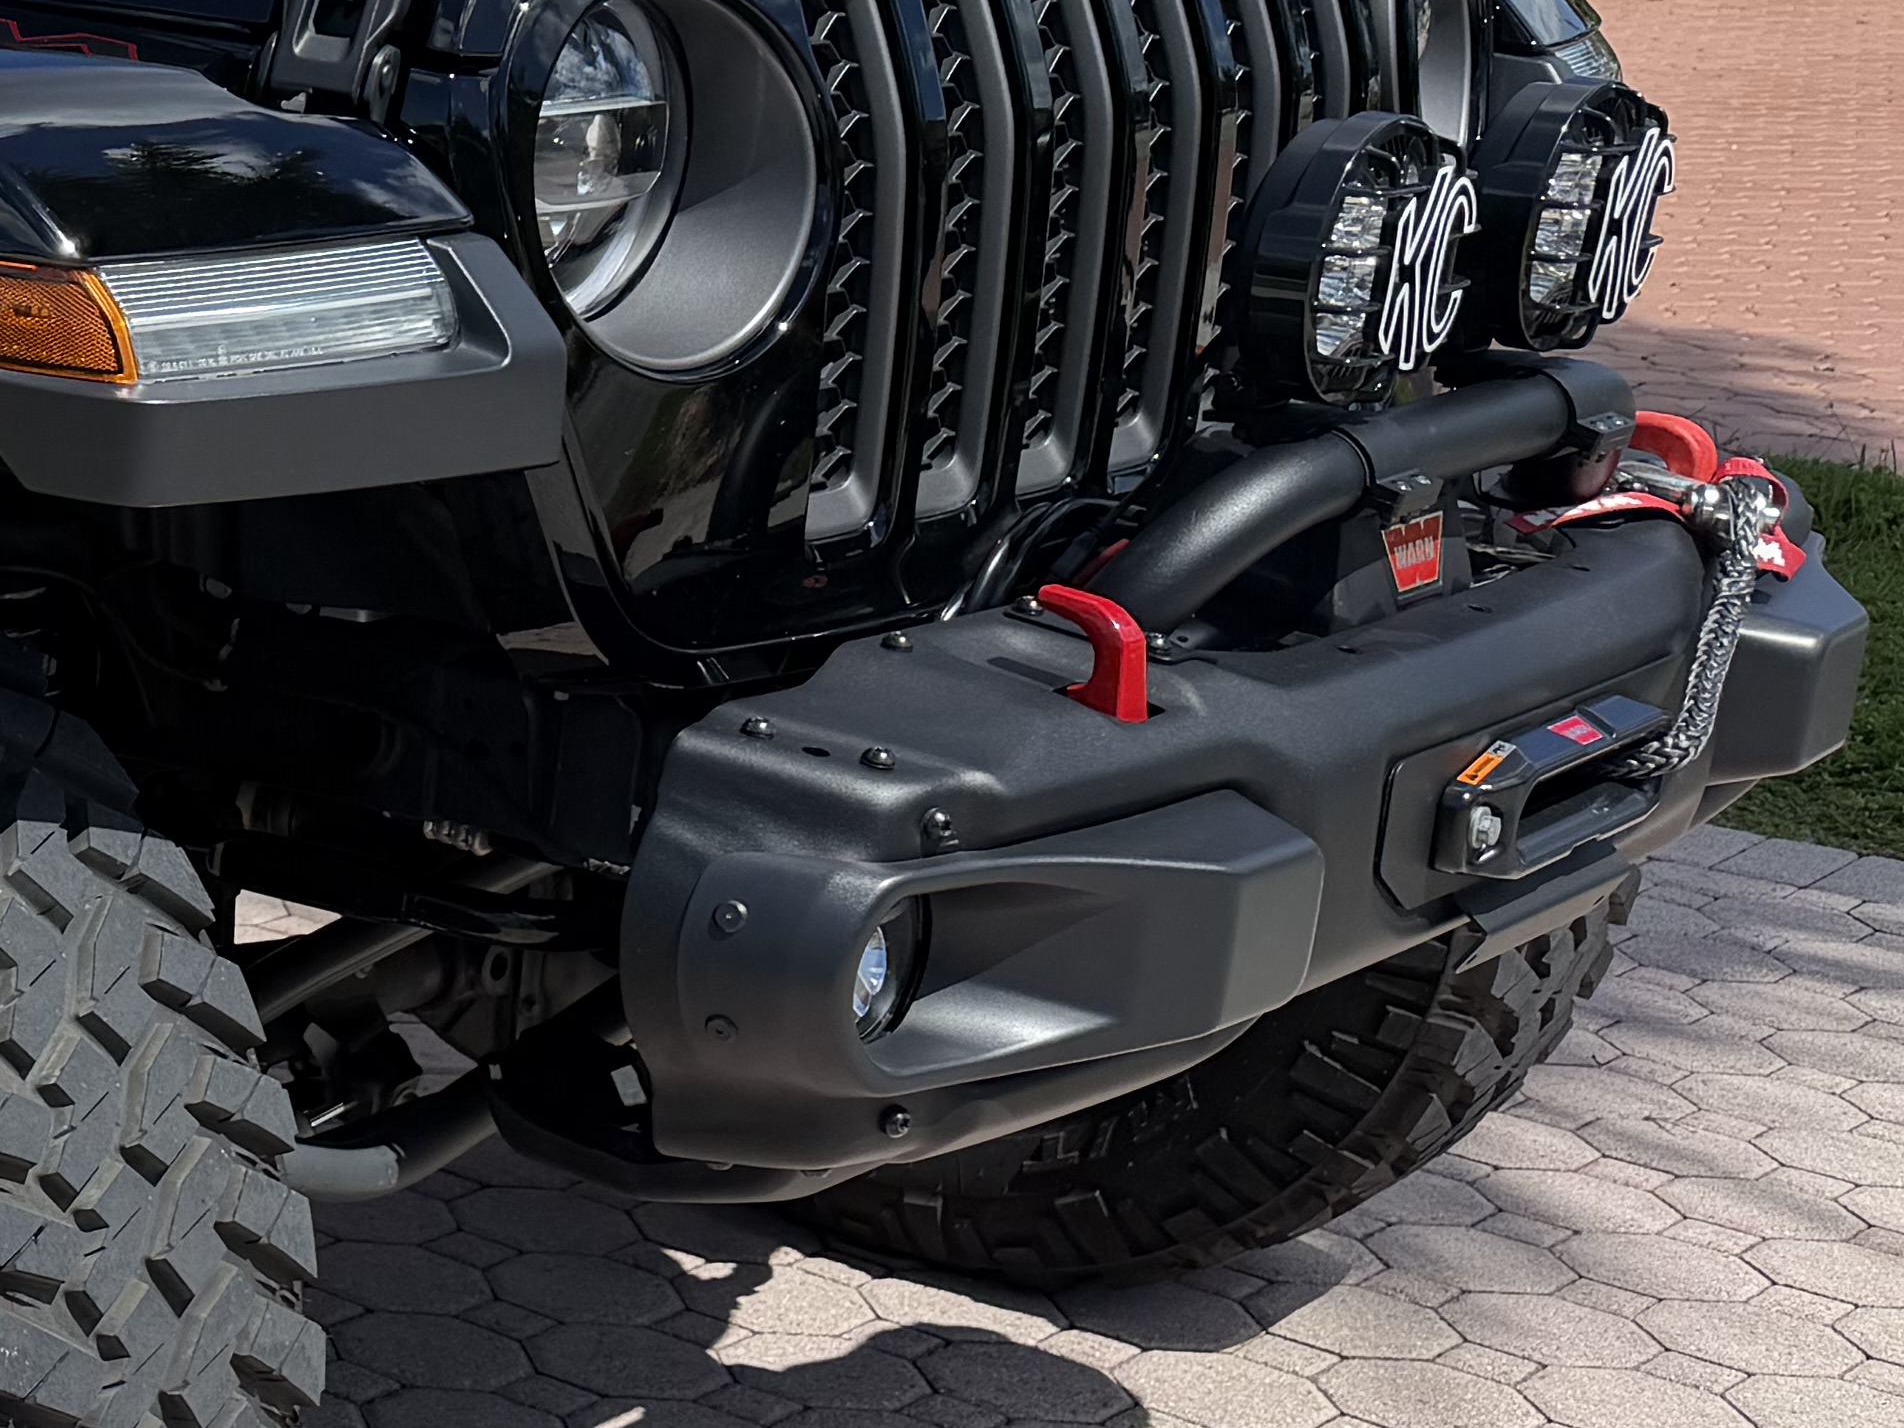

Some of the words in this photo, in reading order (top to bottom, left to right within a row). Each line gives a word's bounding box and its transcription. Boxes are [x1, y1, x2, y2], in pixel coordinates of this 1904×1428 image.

[1379, 165, 1478, 371] KC
[1589, 127, 1676, 320] KC
[1394, 535, 1435, 570] WARN
